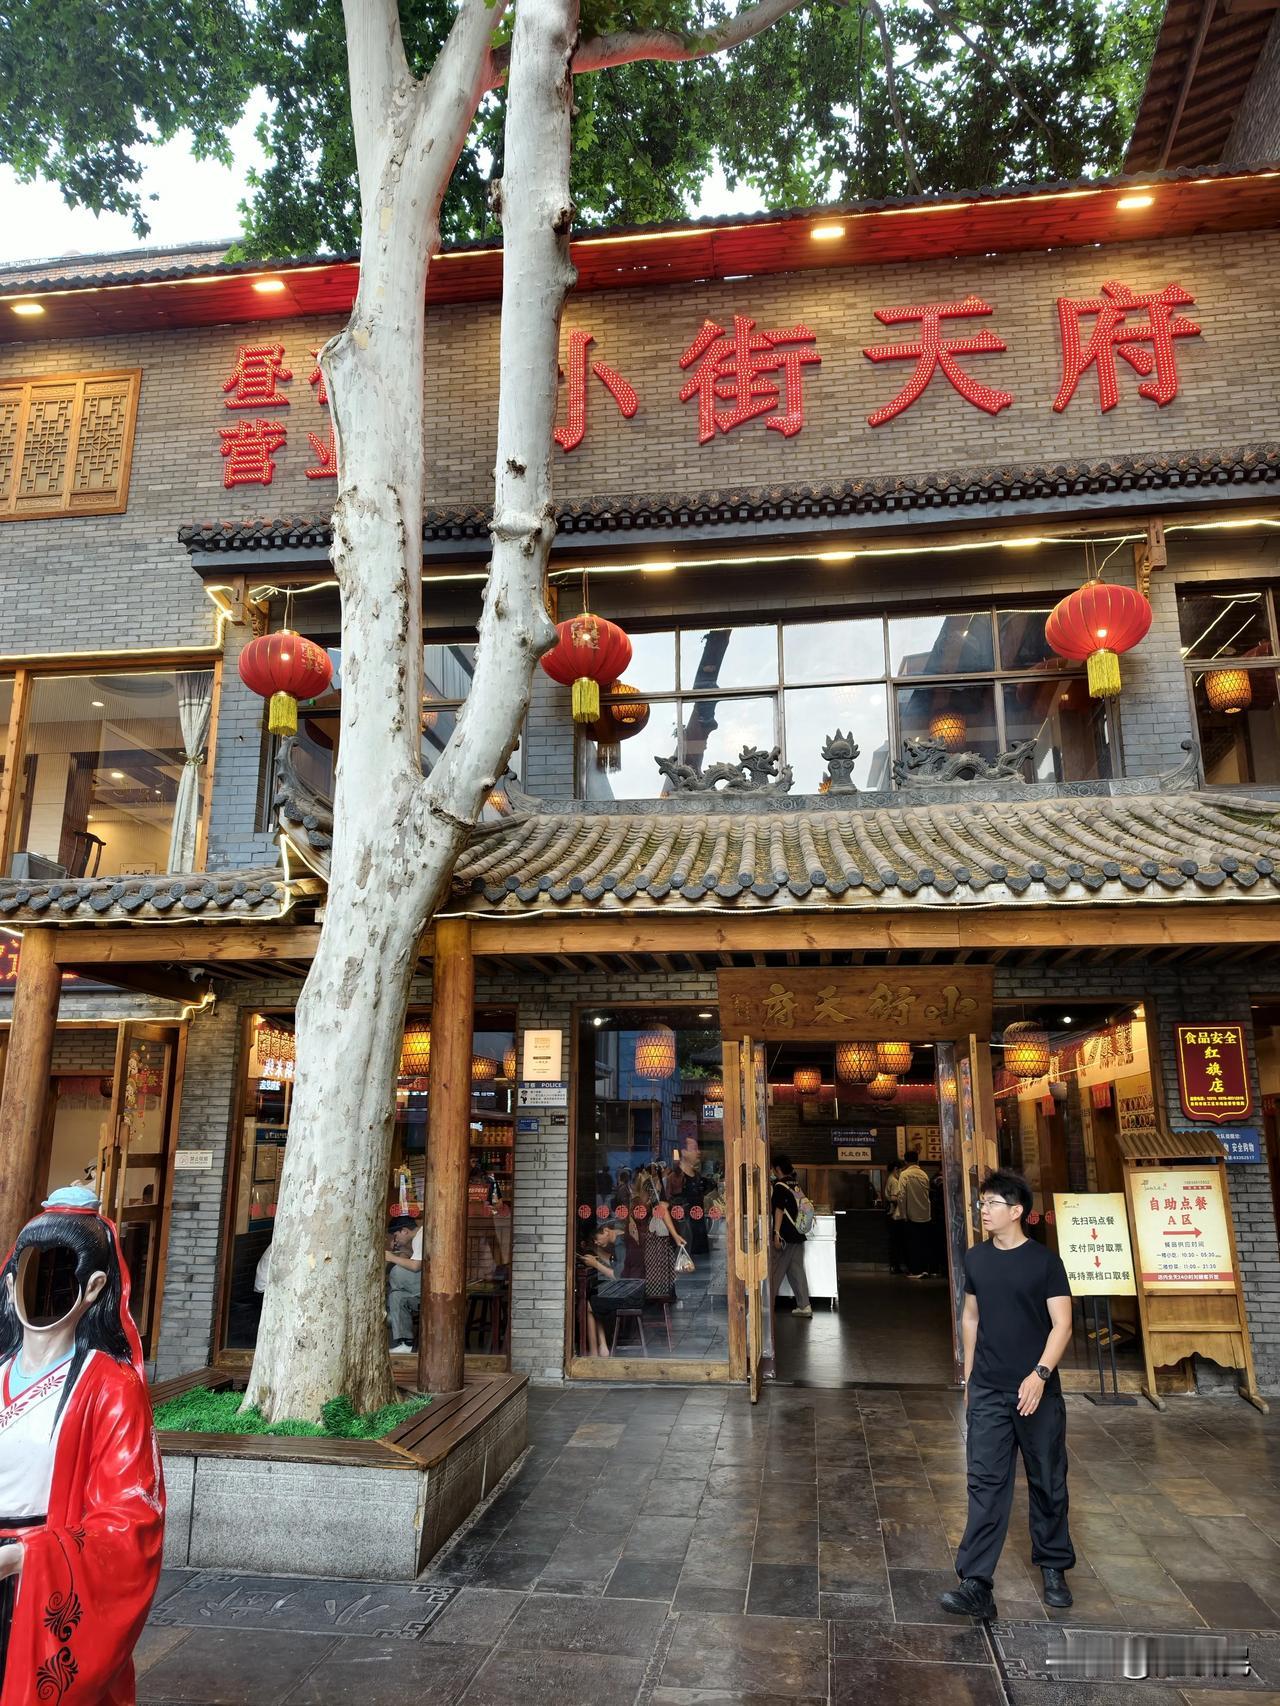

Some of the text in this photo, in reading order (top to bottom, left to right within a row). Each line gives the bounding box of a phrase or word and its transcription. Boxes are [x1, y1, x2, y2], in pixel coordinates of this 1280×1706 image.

[1184, 1031, 1237, 1044] 食品安全
[1204, 1046, 1225, 1093] 红旗店
[1150, 1196, 1208, 1211] 自助点餐
[1071, 1216, 1115, 1226] 先扫码点餐
[1069, 1243, 1123, 1253] 支付同时取票
[1068, 1271, 1130, 1281] 再持票档口取餐
